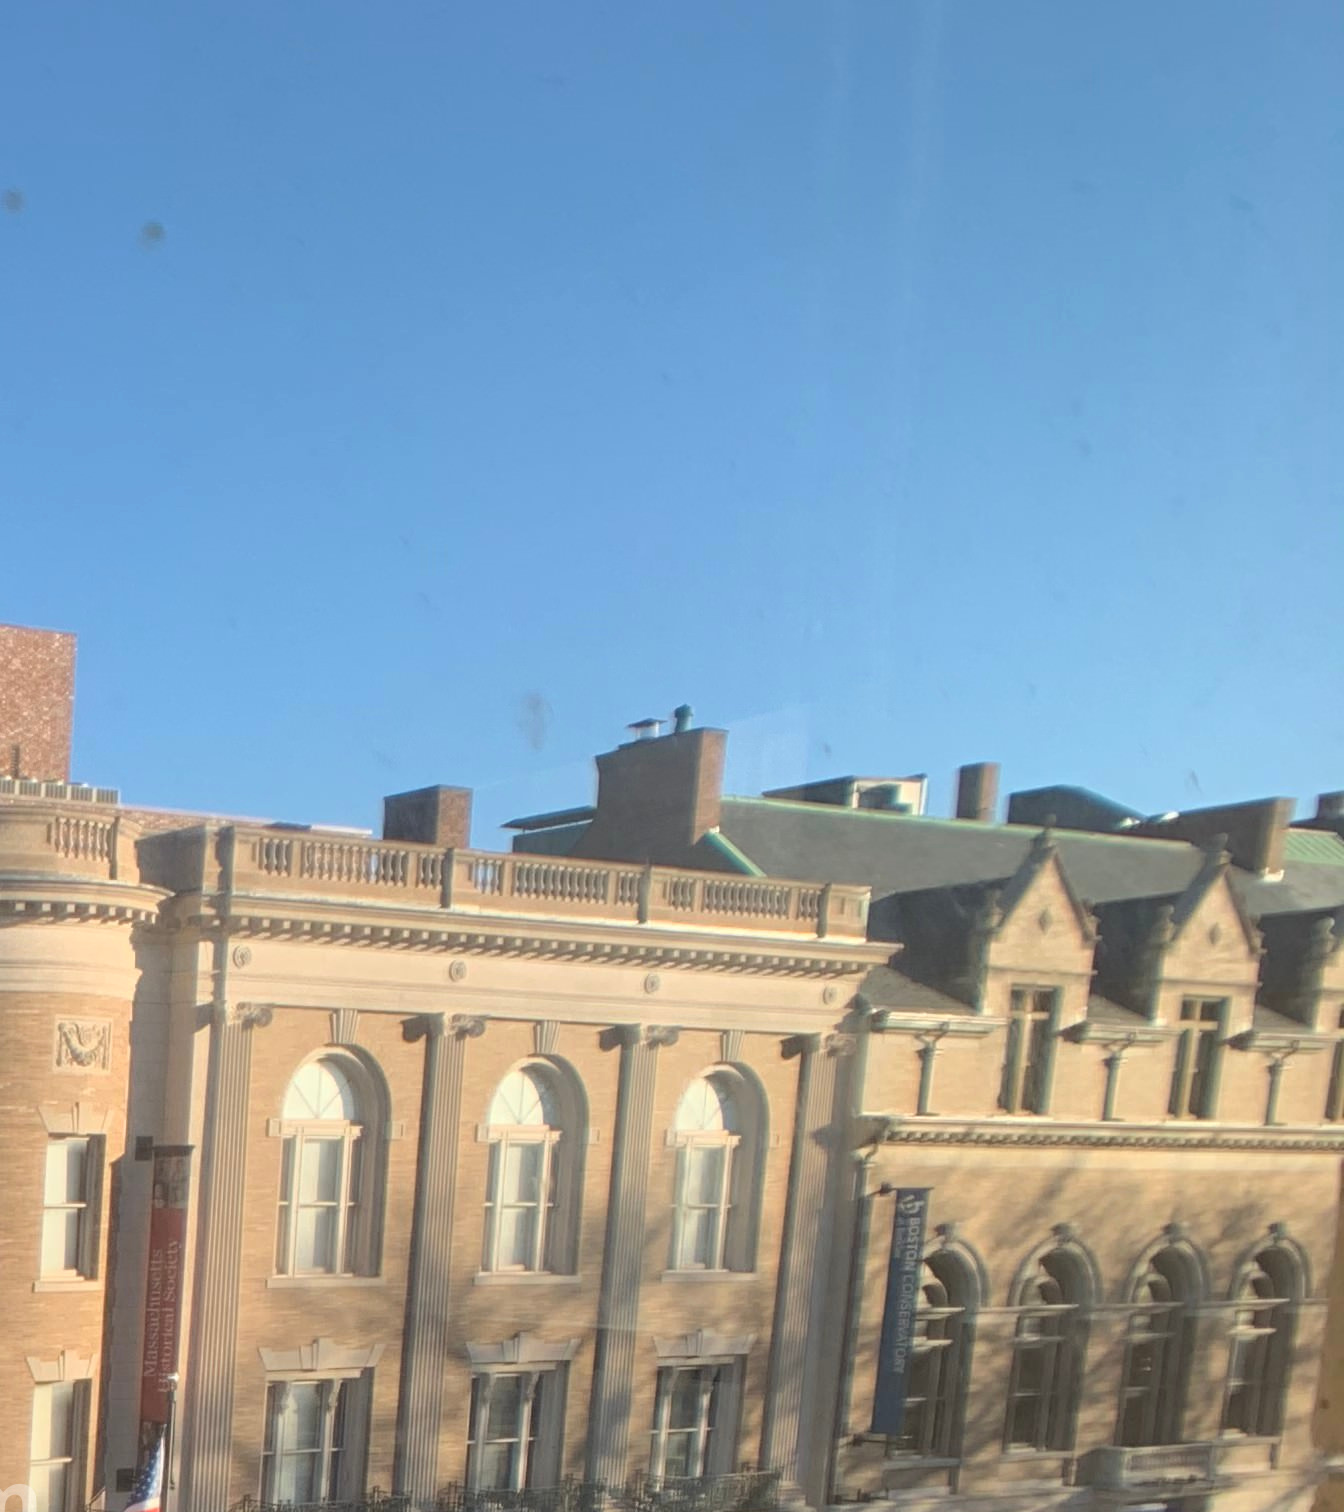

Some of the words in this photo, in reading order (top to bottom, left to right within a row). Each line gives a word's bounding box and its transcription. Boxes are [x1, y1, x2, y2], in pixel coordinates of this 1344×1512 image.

[163, 1240, 182, 1302] Society
[904, 1217, 920, 1271] BOSTON
[144, 1248, 163, 1377] Massachusetts
[893, 1274, 915, 1374] CONSERVATORY
